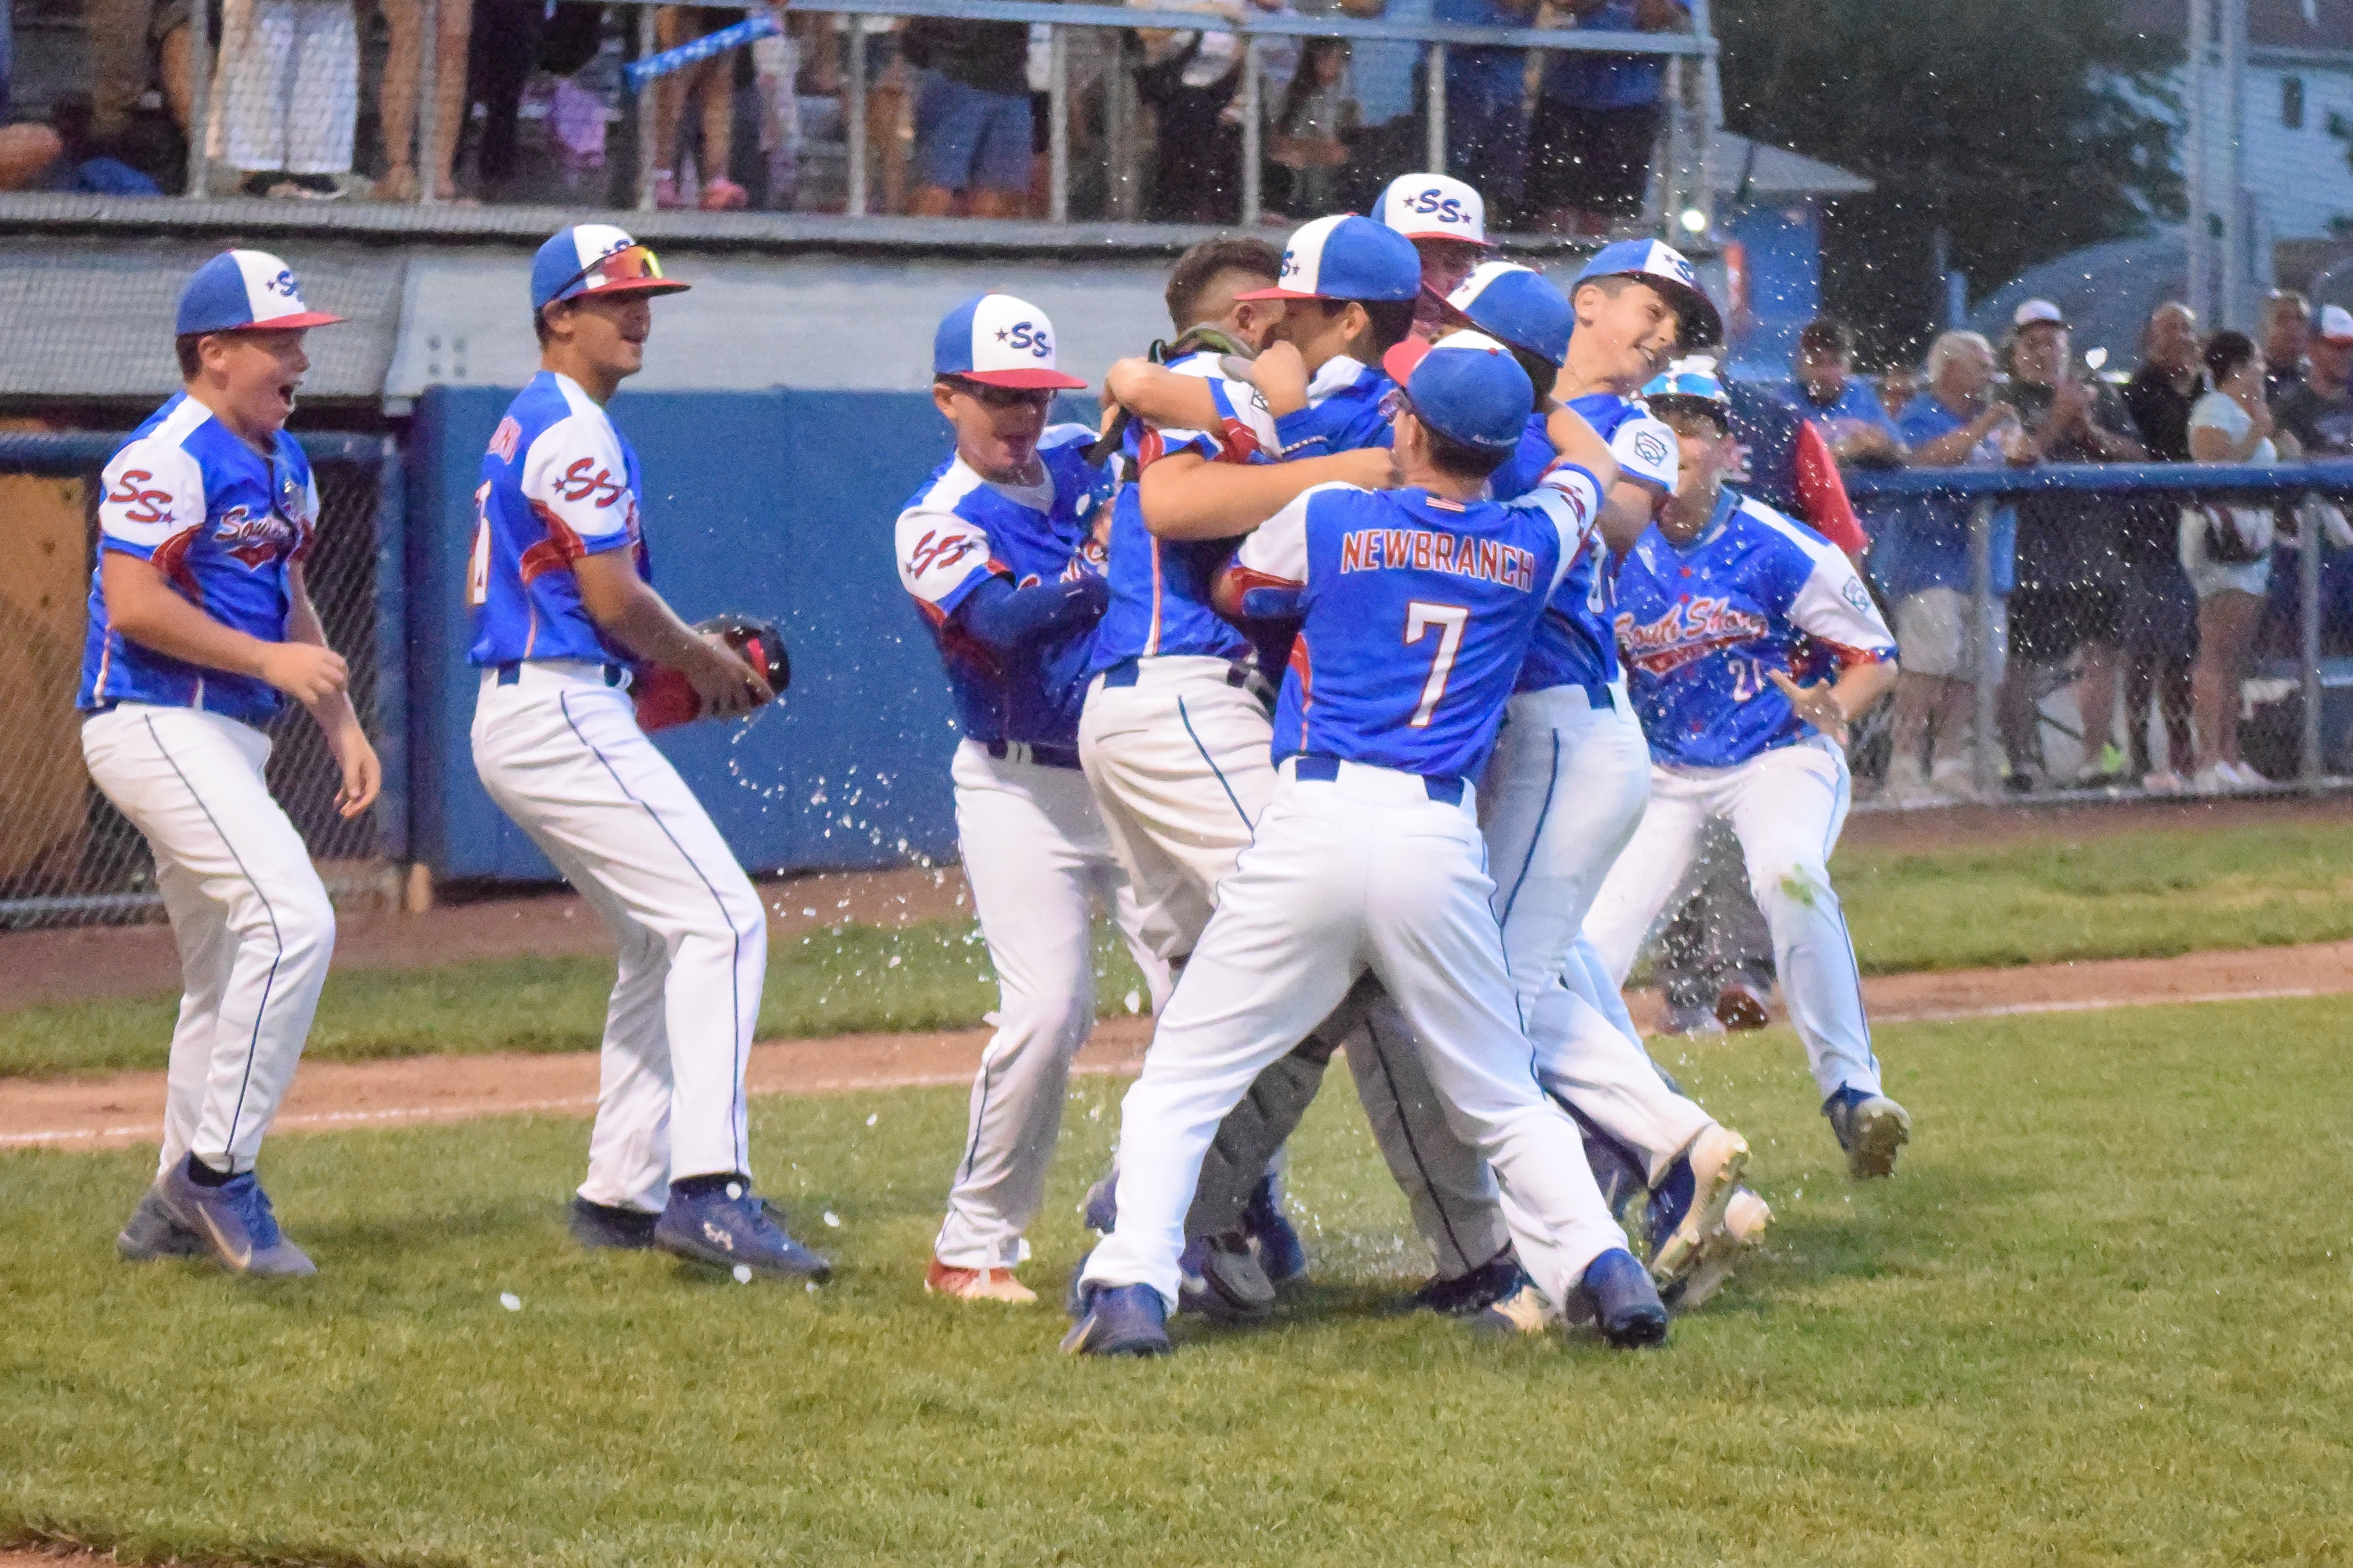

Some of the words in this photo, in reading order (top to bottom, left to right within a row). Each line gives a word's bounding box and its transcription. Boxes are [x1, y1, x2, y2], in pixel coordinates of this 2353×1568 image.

[1416, 189, 1461, 222] SS
[1010, 321, 1052, 357] SS
[109, 470, 174, 524] SS
[564, 457, 627, 508] SS
[912, 530, 967, 580] SS
[1341, 528, 1535, 593] NEWBRANCH
[1404, 600, 1470, 727] 7
